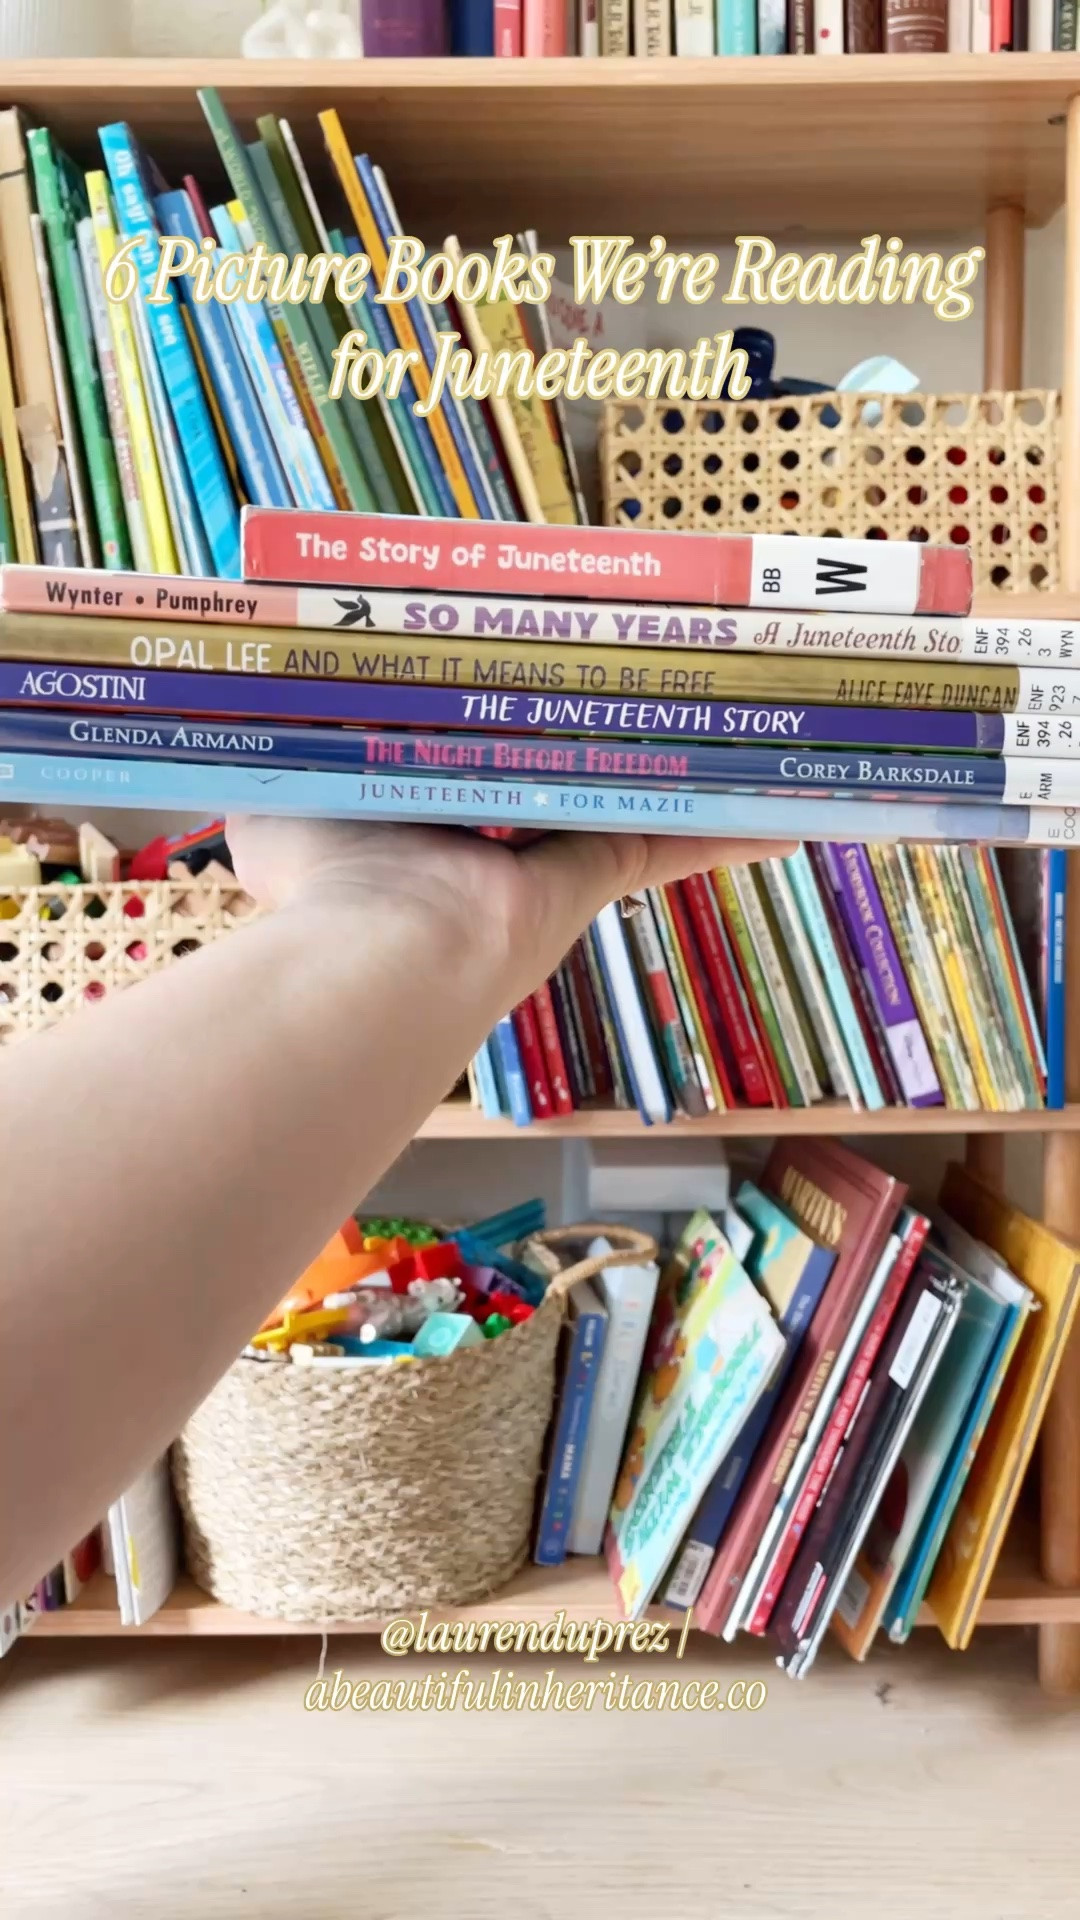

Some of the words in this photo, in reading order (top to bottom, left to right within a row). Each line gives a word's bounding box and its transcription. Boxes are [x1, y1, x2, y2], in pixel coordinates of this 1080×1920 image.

[297, 533, 347, 560] The
[360, 538, 439, 570] Story
[452, 544, 486, 567] of
[497, 544, 661, 578] Juneteenth
[763, 567, 781, 593] BB
[816, 557, 867, 594] W
[46, 581, 123, 609] Wynter
[156, 588, 258, 619] Pumphrey
[404, 602, 459, 632] SO
[474, 606, 599, 640] MANY
[612, 613, 737, 646] YEARS
[753, 622, 781, 645] A
[787, 622, 915, 653] Juneteenth
[975, 627, 989, 654] ENF
[995, 627, 1009, 655] 394
[1038, 648, 1051, 657] 3
[1059, 630, 1074, 658] WYN
[130, 635, 213, 672] OPAL
[227, 642, 272, 673] LEE
[284, 649, 340, 677] AND
[352, 652, 431, 682] WHAT
[442, 656, 463, 682] IT
[474, 660, 565, 689] MEANS
[576, 665, 607, 689] TO
[620, 668, 650, 692] BE
[661, 671, 717, 696] FREE
[19, 670, 146, 701] AGOSTINI
[835, 678, 888, 702] ALICE
[894, 681, 936, 706] FAYE
[941, 683, 1019, 709] DUNCAN
[1028, 684, 1046, 711] ENF
[1049, 685, 1066, 711] 923
[462, 695, 517, 722] THE
[527, 697, 711, 733] JUNETEENTH
[723, 706, 805, 735] STORY
[69, 720, 163, 747] GLENDA
[170, 727, 274, 753] ARMAND
[1016, 720, 1031, 747] ENF
[1037, 720, 1051, 748] 394
[364, 735, 404, 764] THE
[414, 738, 486, 768] NIGHT
[492, 743, 576, 772] BEFORE
[587, 747, 688, 777] FREEDOM
[41, 767, 130, 783] COOPER
[780, 757, 850, 780] COREY
[857, 760, 975, 786] BARKSDALE
[1037, 773, 1053, 800] ARM
[359, 783, 523, 806] JUNETEENTH
[559, 793, 605, 811] FOR
[618, 796, 695, 814] MAZIE
